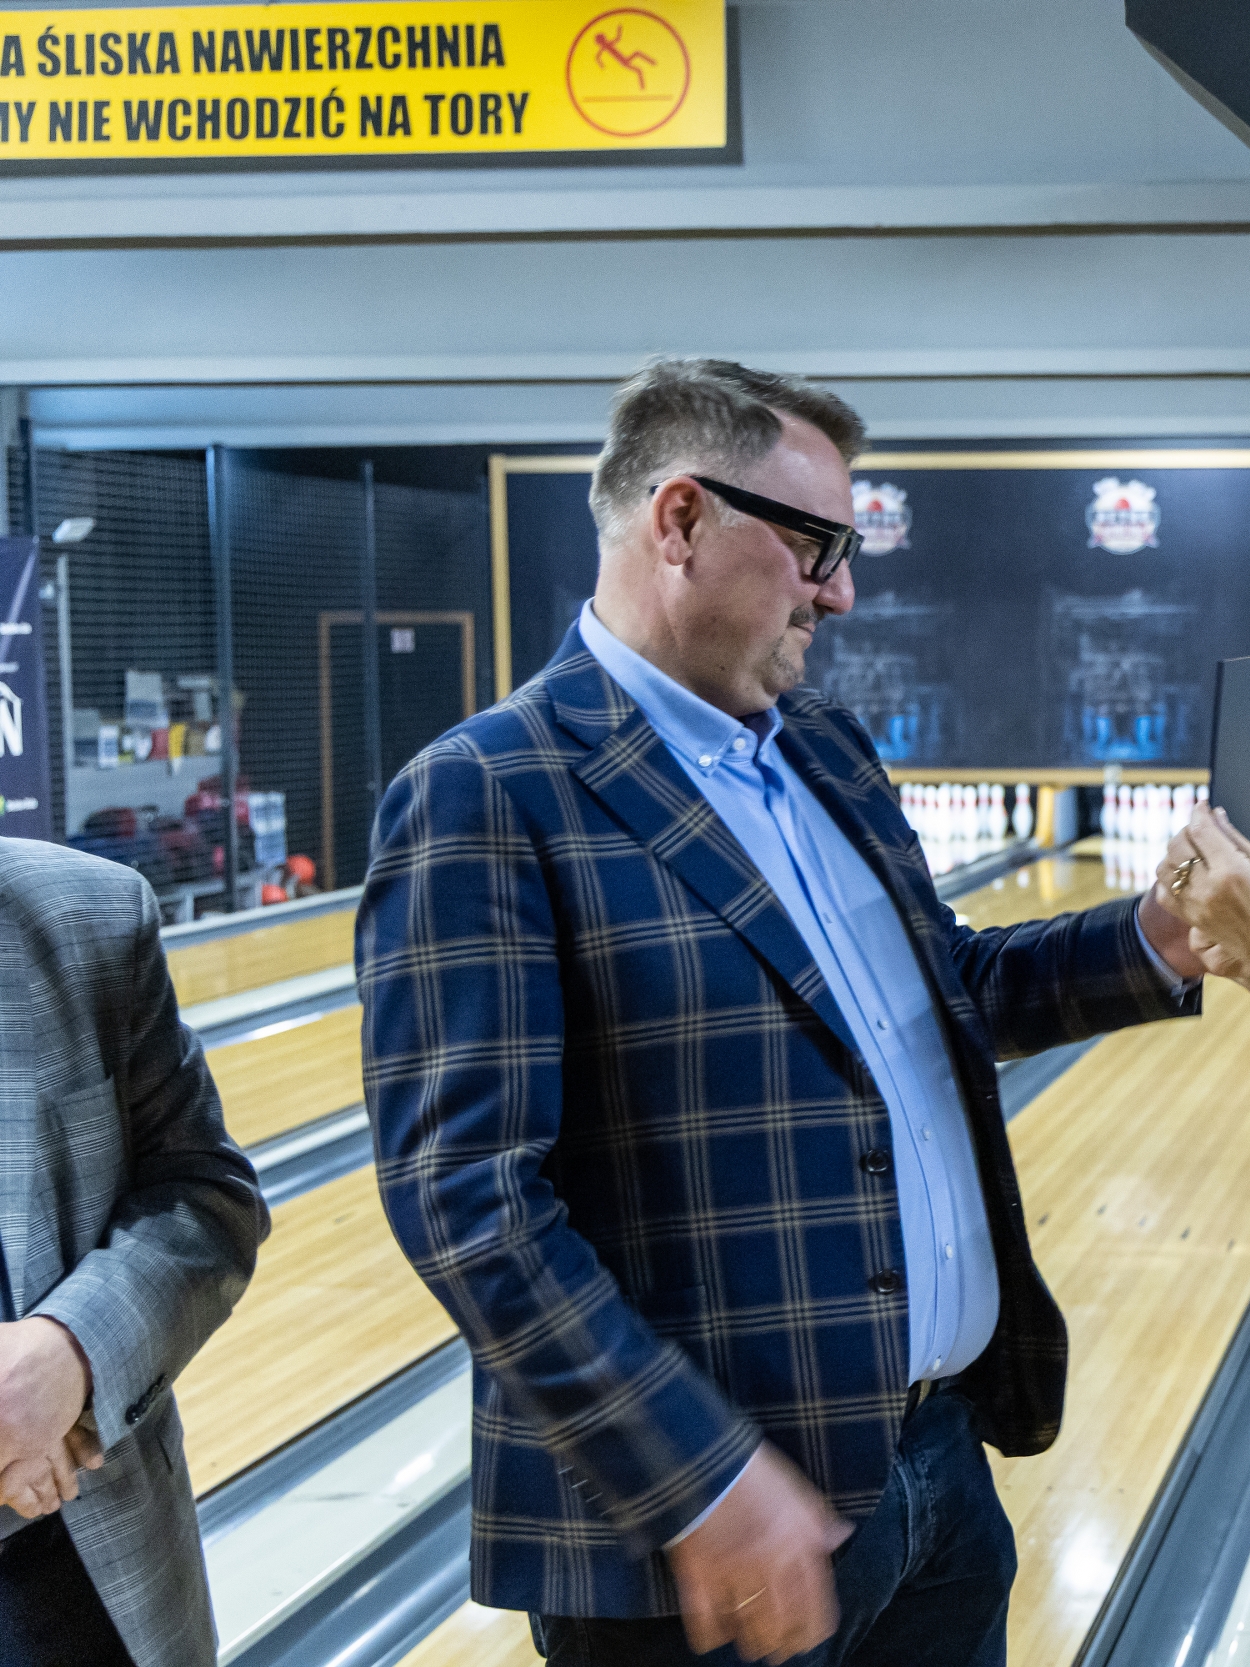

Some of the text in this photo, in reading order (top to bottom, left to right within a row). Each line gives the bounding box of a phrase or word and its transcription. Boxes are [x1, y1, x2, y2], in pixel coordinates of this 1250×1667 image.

[37, 25, 181, 77] ŚLISKA
[192, 23, 506, 75] NAWIERZCHNIA
[49, 100, 111, 142] NIE
[123, 86, 346, 141] WCHODZIĆ
[360, 95, 412, 137] NA
[424, 92, 530, 136] TORY
